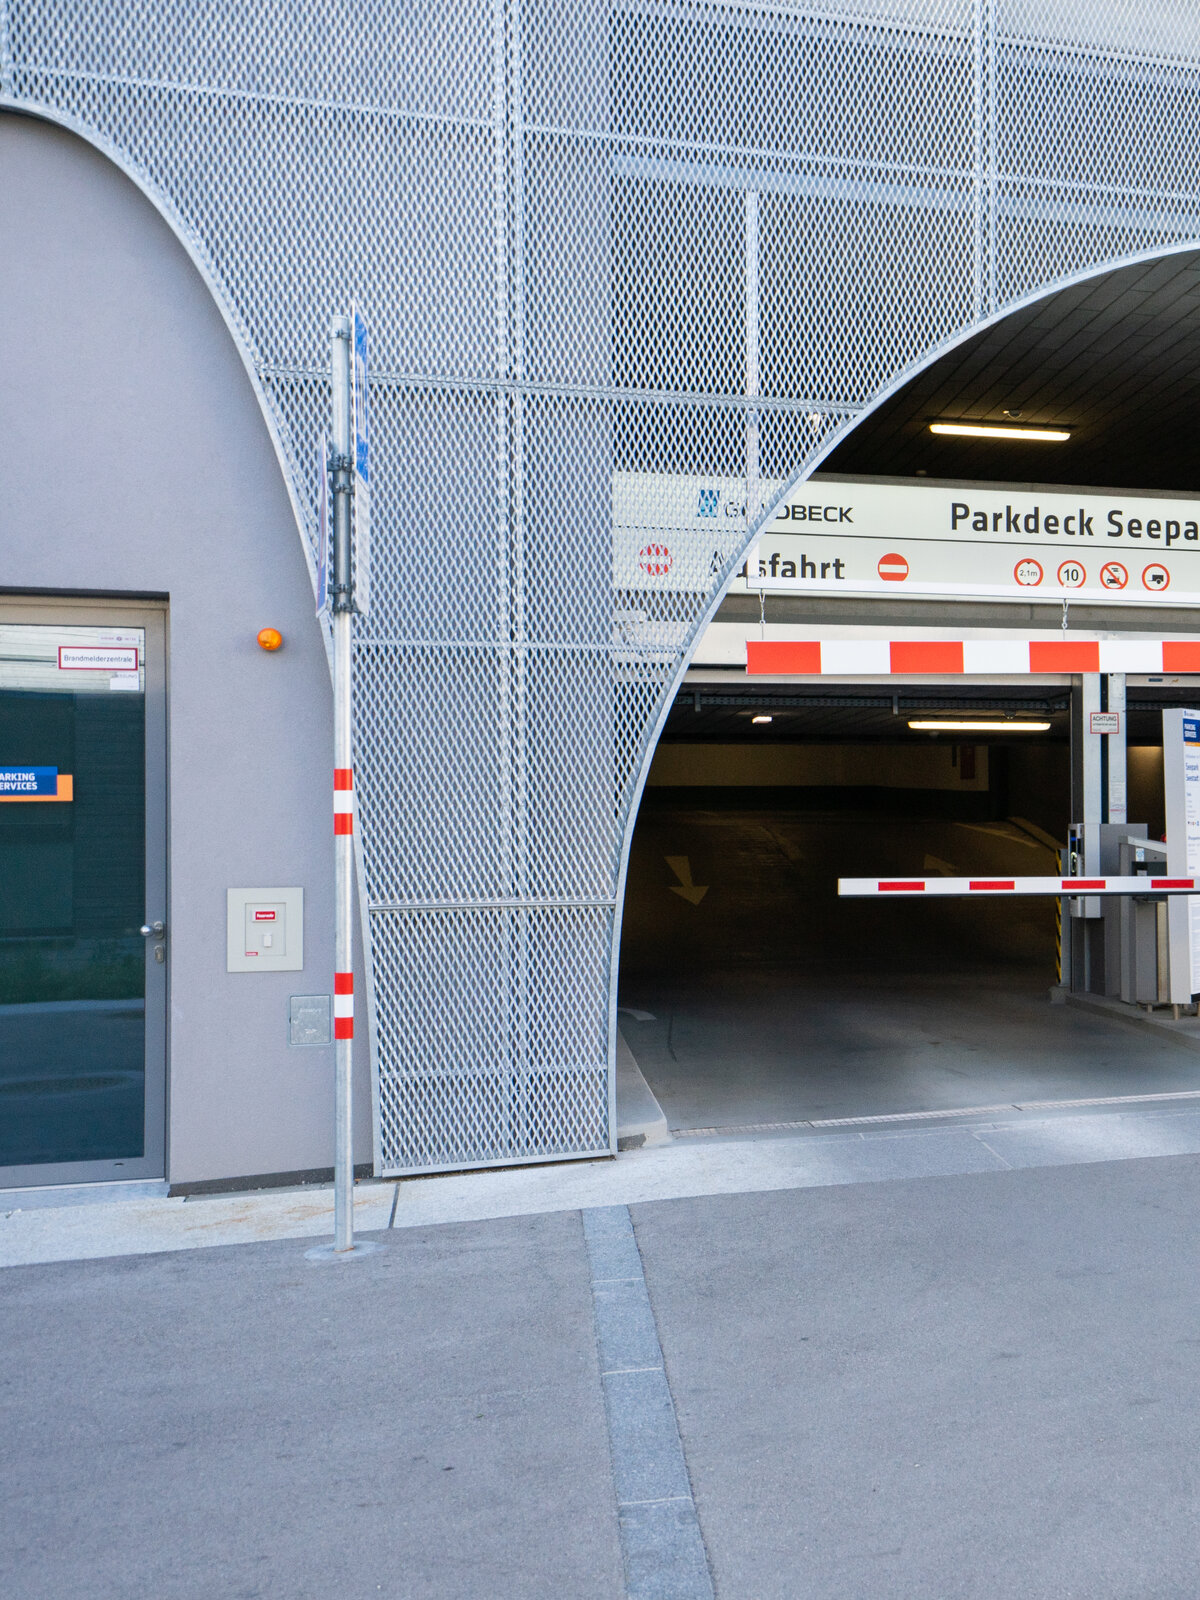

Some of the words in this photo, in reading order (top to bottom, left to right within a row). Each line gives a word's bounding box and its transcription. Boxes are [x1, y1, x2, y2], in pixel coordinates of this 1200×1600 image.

[951, 502, 1094, 537] Parkdeck
[1063, 568, 1079, 582] 10
[63, 654, 133, 663] Brandmelderzentrale
[0, 772, 36, 782] ARKING
[0, 781, 38, 791] ERVICES
